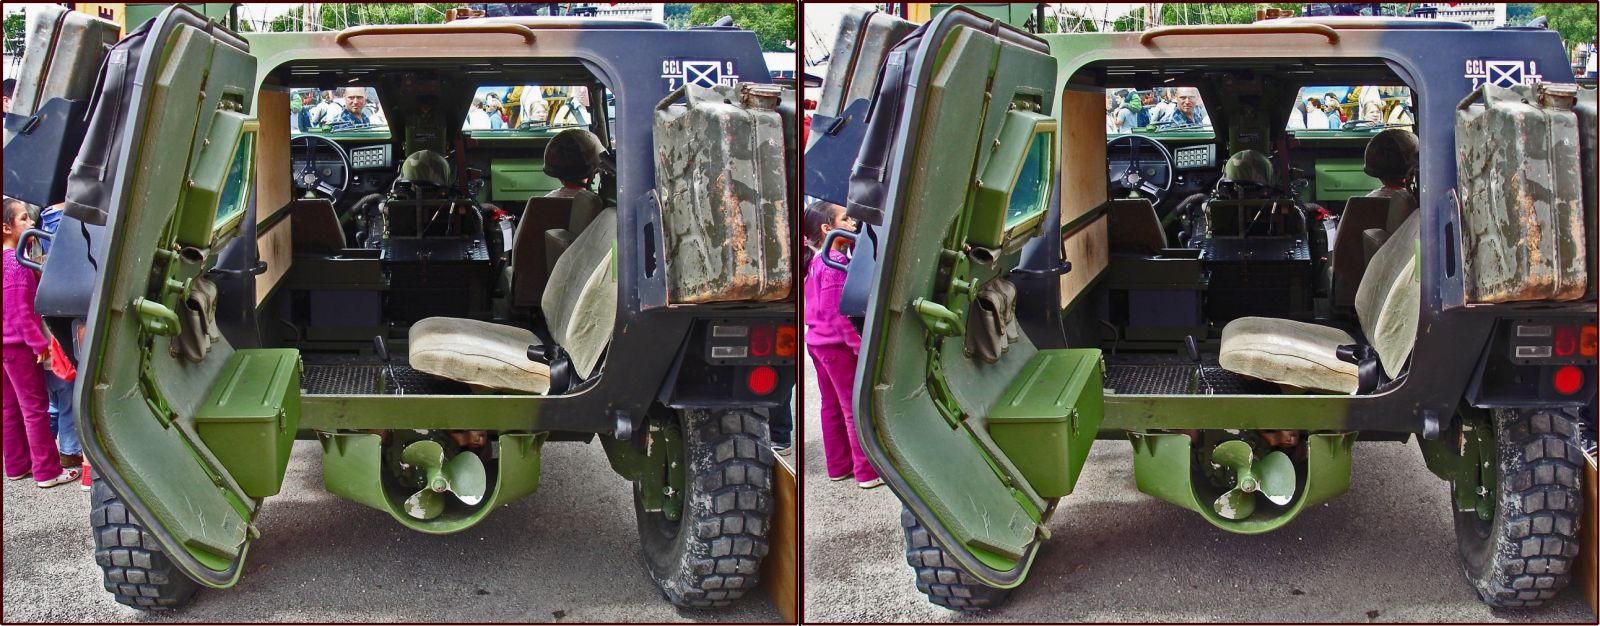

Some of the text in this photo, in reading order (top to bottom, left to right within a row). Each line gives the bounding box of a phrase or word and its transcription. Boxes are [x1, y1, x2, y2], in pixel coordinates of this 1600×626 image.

[662, 60, 682, 74] CCL
[726, 62, 732, 75] 9
[1466, 60, 1485, 74] CCL
[669, 78, 675, 92] 2
